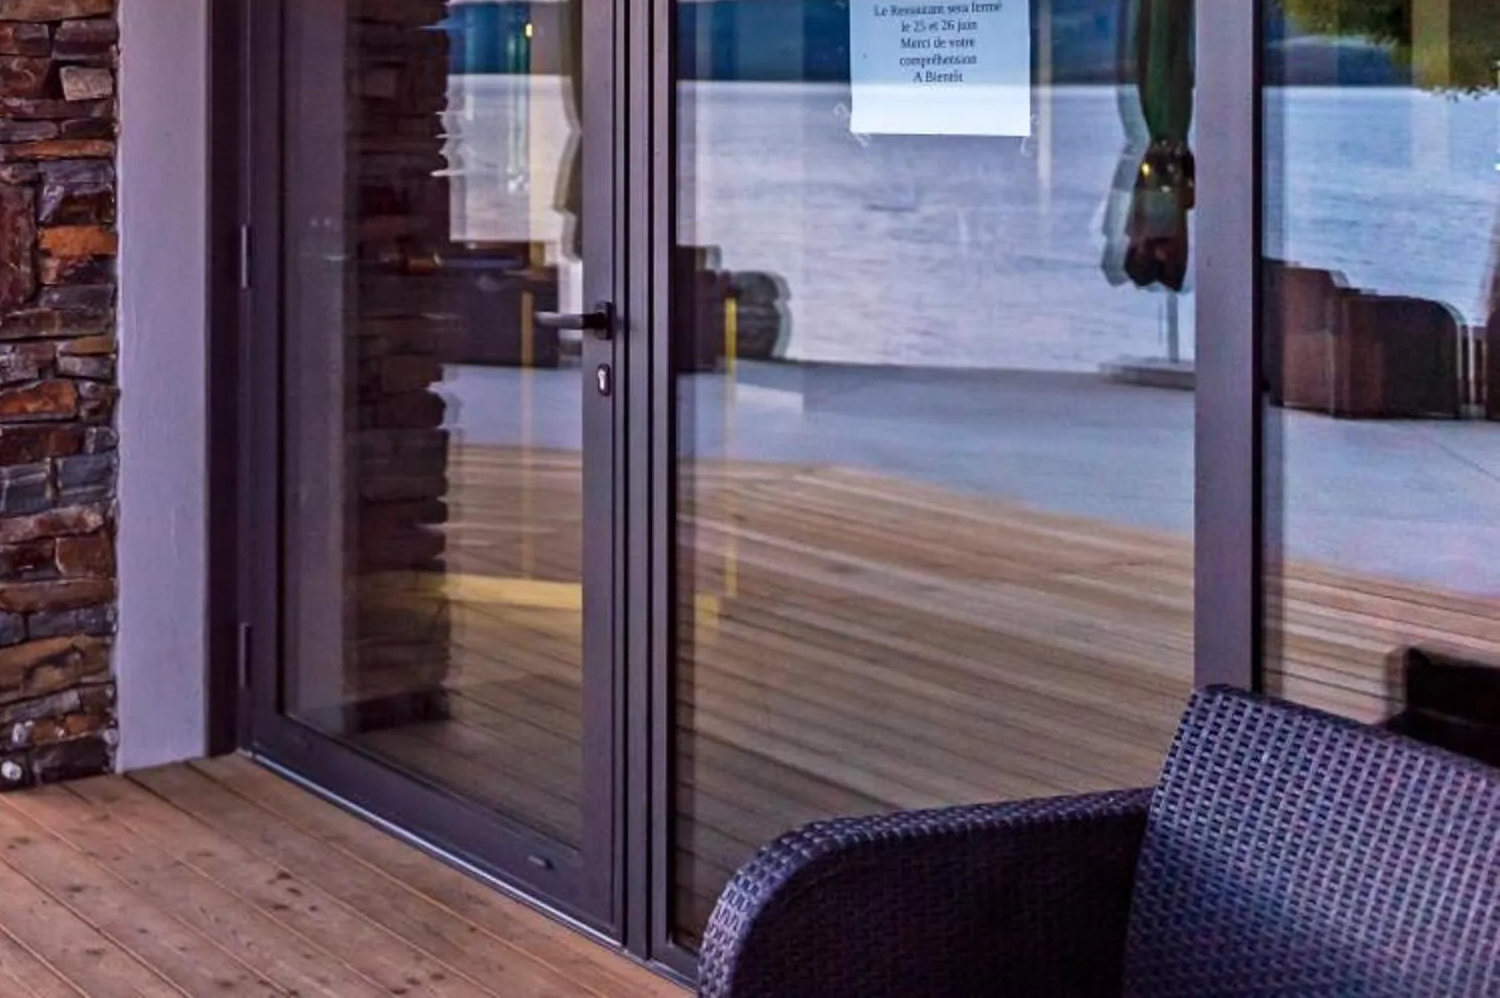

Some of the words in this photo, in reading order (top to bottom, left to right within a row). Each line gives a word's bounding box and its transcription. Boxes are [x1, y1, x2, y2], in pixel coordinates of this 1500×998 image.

[873, 4, 888, 17] Le
[901, 20, 911, 32] le
[913, 20, 926, 32] 25
[928, 21, 939, 31] et
[941, 19, 955, 30] 26
[957, 19, 978, 32] juin
[901, 37, 931, 48] Merci
[933, 36, 947, 48] de
[949, 38, 975, 48] votre
[900, 54, 977, 68] compréhension
[913, 72, 923, 82] A
